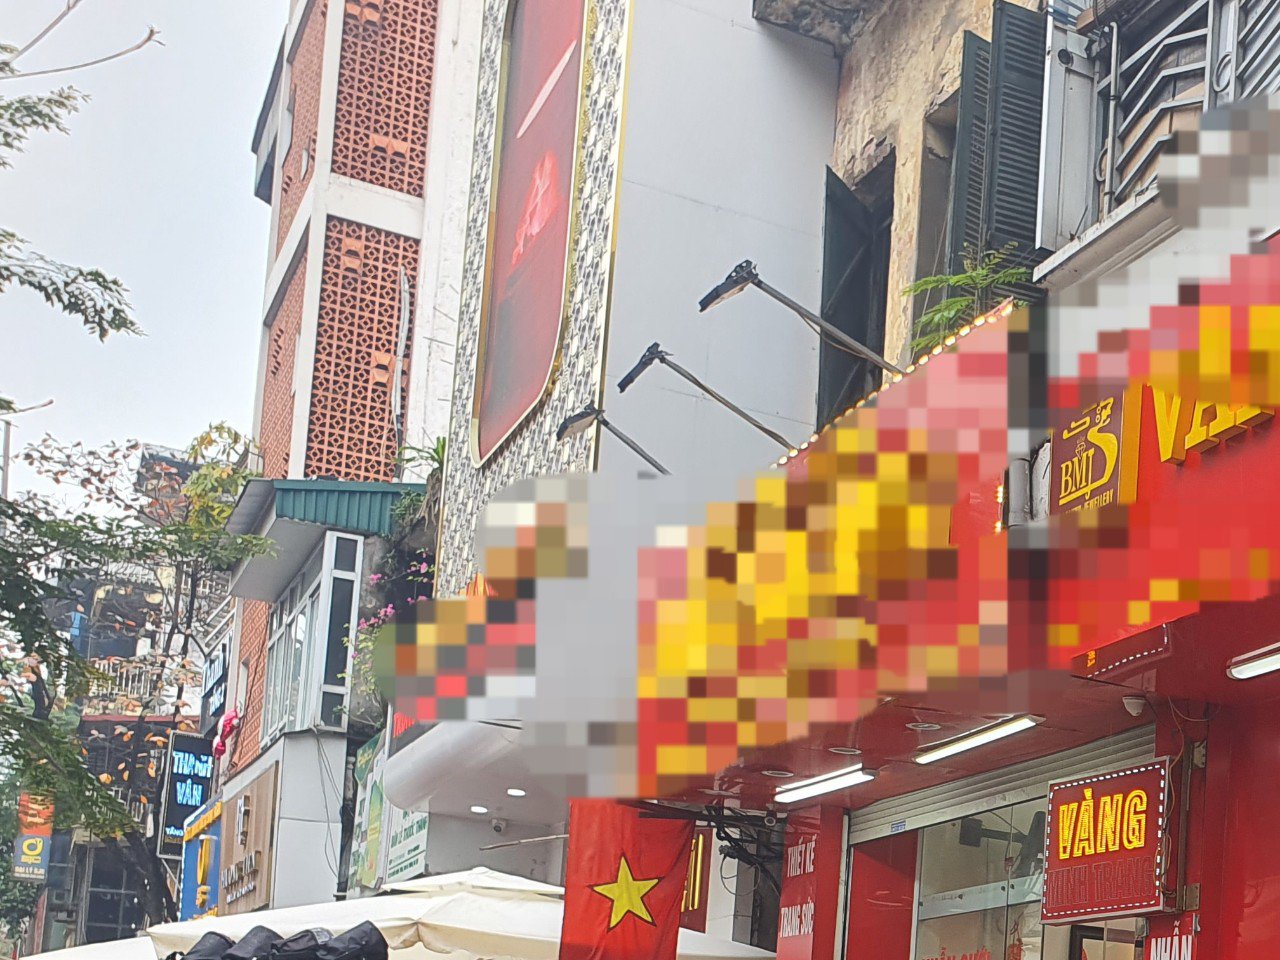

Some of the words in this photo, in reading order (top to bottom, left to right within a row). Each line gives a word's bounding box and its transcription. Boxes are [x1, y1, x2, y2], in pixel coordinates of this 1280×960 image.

[1058, 788, 1148, 860] VÀNG
[1047, 864, 1089, 908] MINH
[1092, 856, 1155, 902] TRANG
[779, 904, 801, 938] TRANG
[800, 896, 815, 935] SỨC
